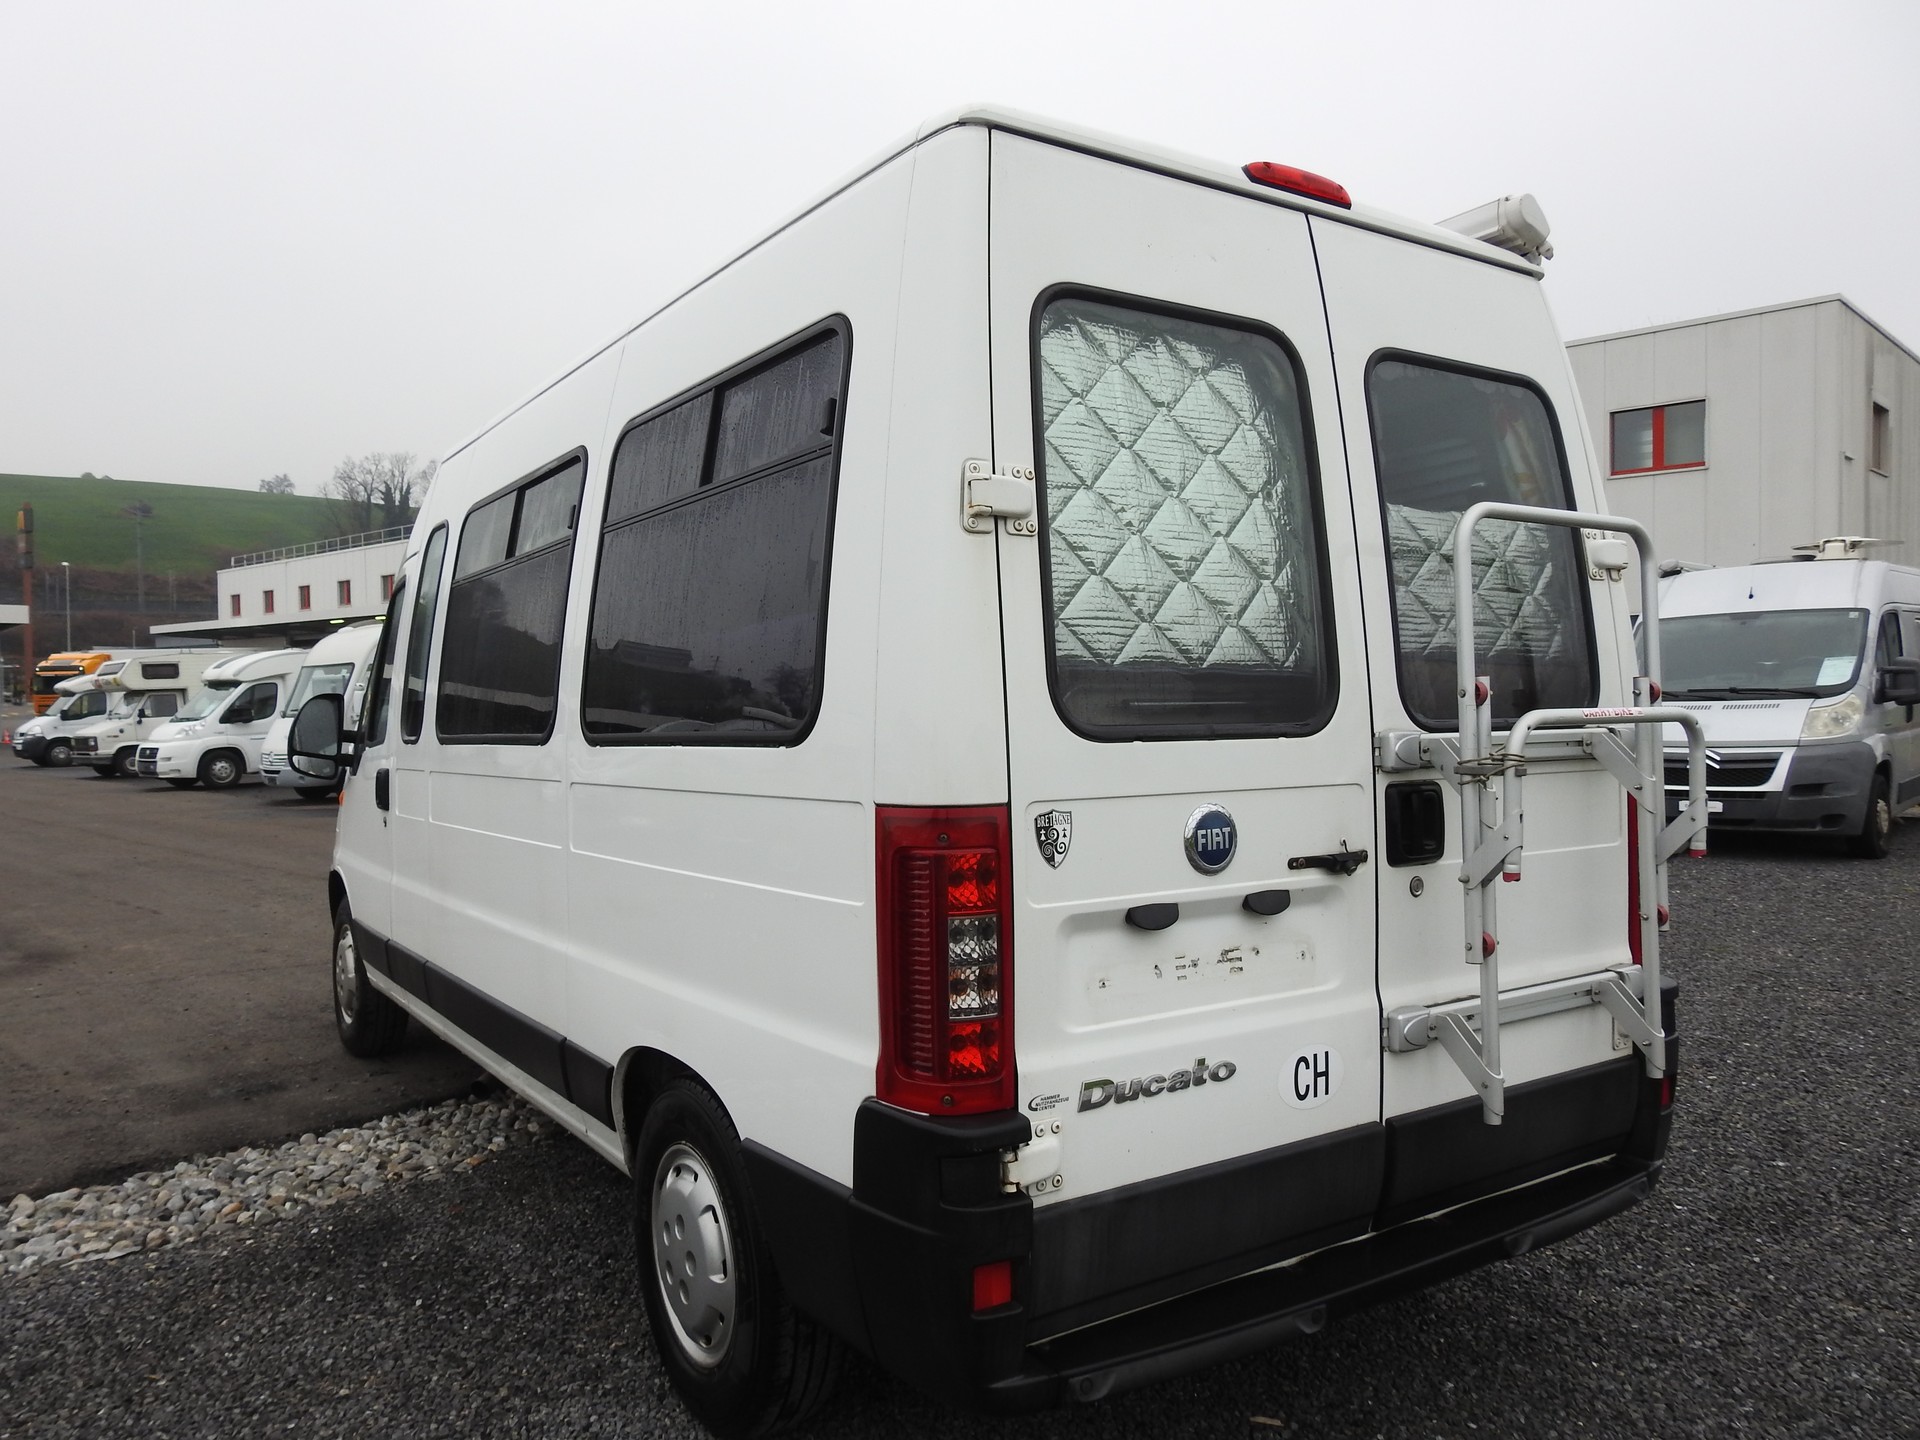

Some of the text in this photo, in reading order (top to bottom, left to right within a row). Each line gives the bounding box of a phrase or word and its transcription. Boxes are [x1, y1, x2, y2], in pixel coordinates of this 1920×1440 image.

[1036, 813, 1071, 828] BRETAGNE
[1197, 827, 1231, 852] FIAT
[1077, 1057, 1236, 1112] Ducato
[1294, 1051, 1329, 1101] CH
